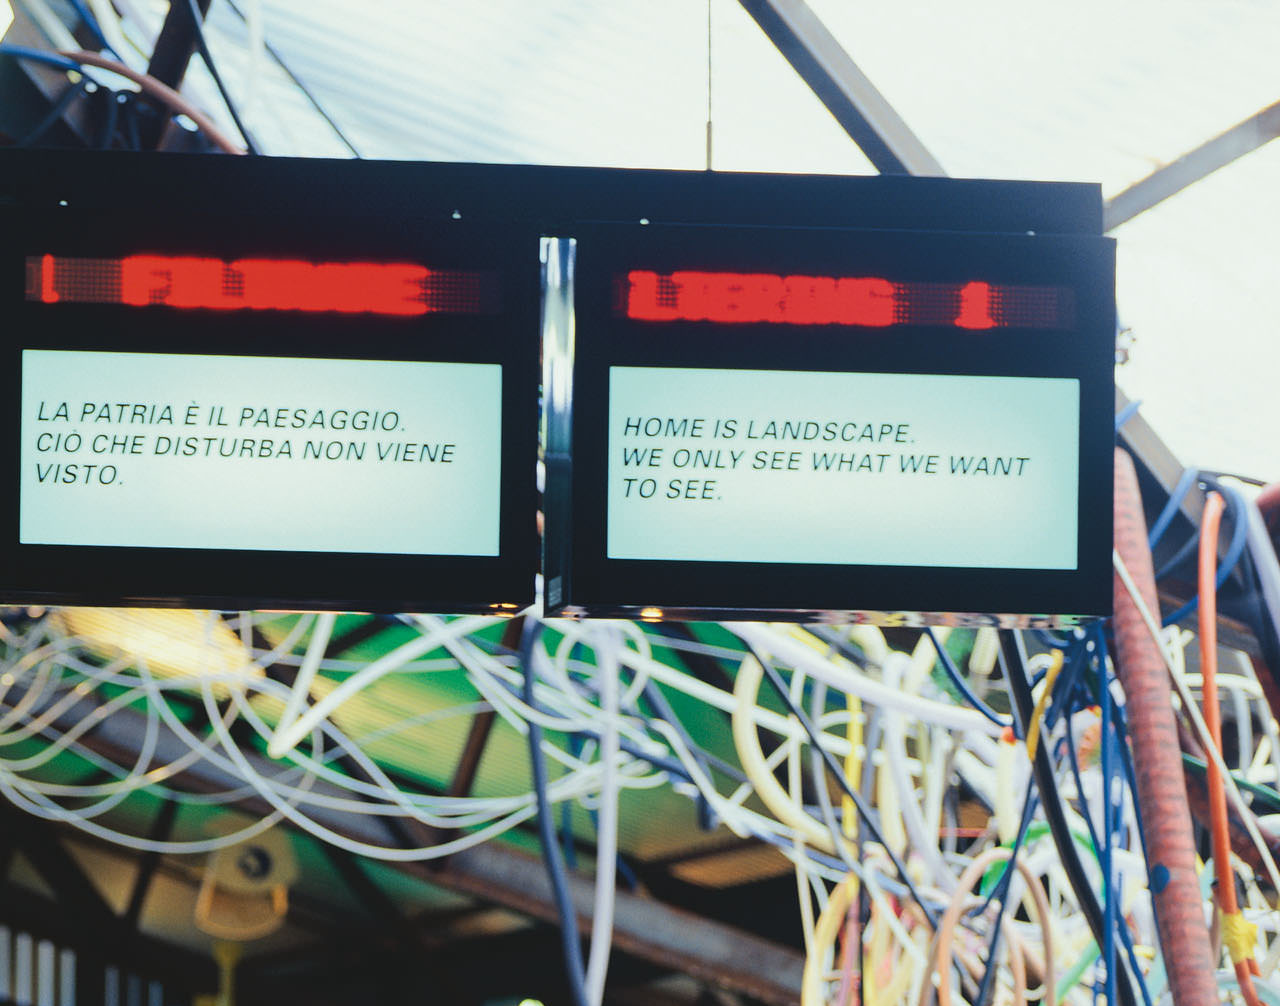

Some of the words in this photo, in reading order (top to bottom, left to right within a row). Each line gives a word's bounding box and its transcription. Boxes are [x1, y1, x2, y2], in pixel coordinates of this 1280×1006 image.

[37, 400, 70, 423] LA
[79, 402, 174, 425] PATRIA
[183, 400, 201, 426] È
[207, 405, 229, 427] IL
[238, 407, 406, 432] PAESAGGIO.
[623, 416, 706, 439] HOME
[713, 419, 738, 440] IS
[746, 419, 916, 444] LANDSCAPE.
[36, 428, 82, 454] CIÒ
[91, 433, 146, 455] CHE
[153, 435, 293, 460] DISTURBA
[302, 440, 366, 461] NON
[376, 441, 457, 464] VIENE
[35, 463, 124, 486] VISTO.
[623, 447, 664, 468] WE
[672, 448, 745, 470] ONLY
[751, 450, 803, 471] SEE
[812, 451, 892, 473] WHAT
[900, 454, 940, 475] WE
[950, 455, 1031, 477] WANT
[623, 477, 657, 499] TO
[665, 478, 722, 501] SEE.
